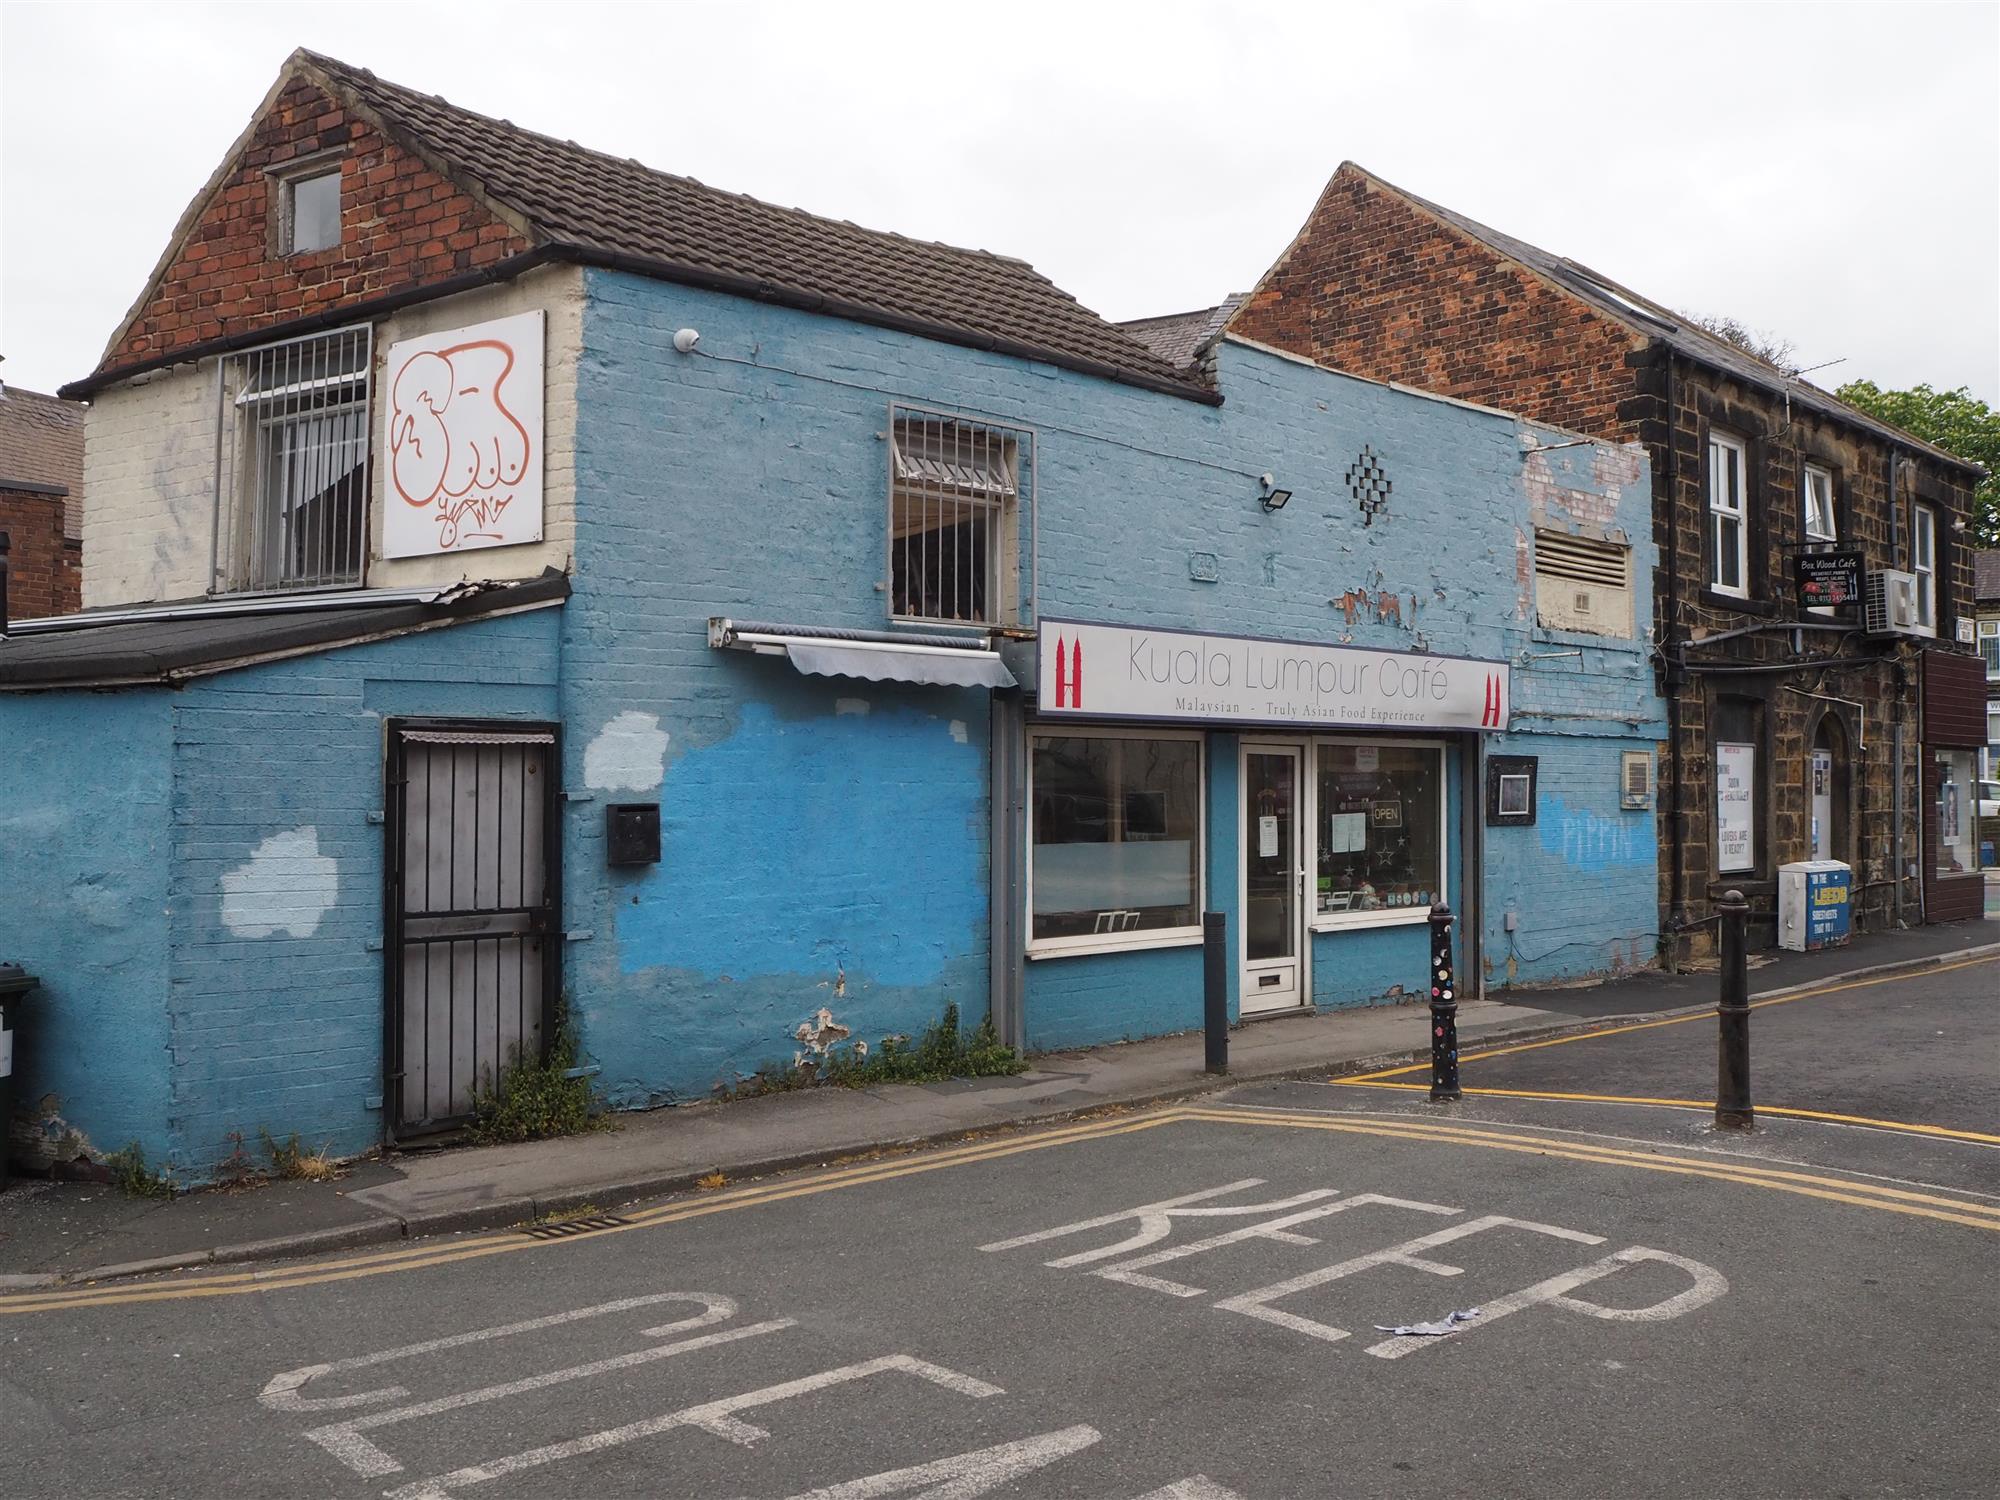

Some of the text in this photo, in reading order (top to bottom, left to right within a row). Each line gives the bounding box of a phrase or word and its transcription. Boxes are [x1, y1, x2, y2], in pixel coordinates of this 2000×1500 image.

[1816, 560, 1837, 569] Wood
[1838, 558, 1857, 568] Cafe
[1129, 635, 1448, 705] Kuala Lumpur Café
[1175, 697, 1240, 714] Malaysian
[1266, 701, 1297, 717] Truly
[1302, 704, 1335, 718] Asian
[1340, 705, 1366, 719] Food
[1371, 707, 1425, 723] Experience
[1374, 807, 1399, 820] OPEN
[1814, 886, 1848, 906] LEEDS
[976, 1178, 1729, 1360] KEEP
